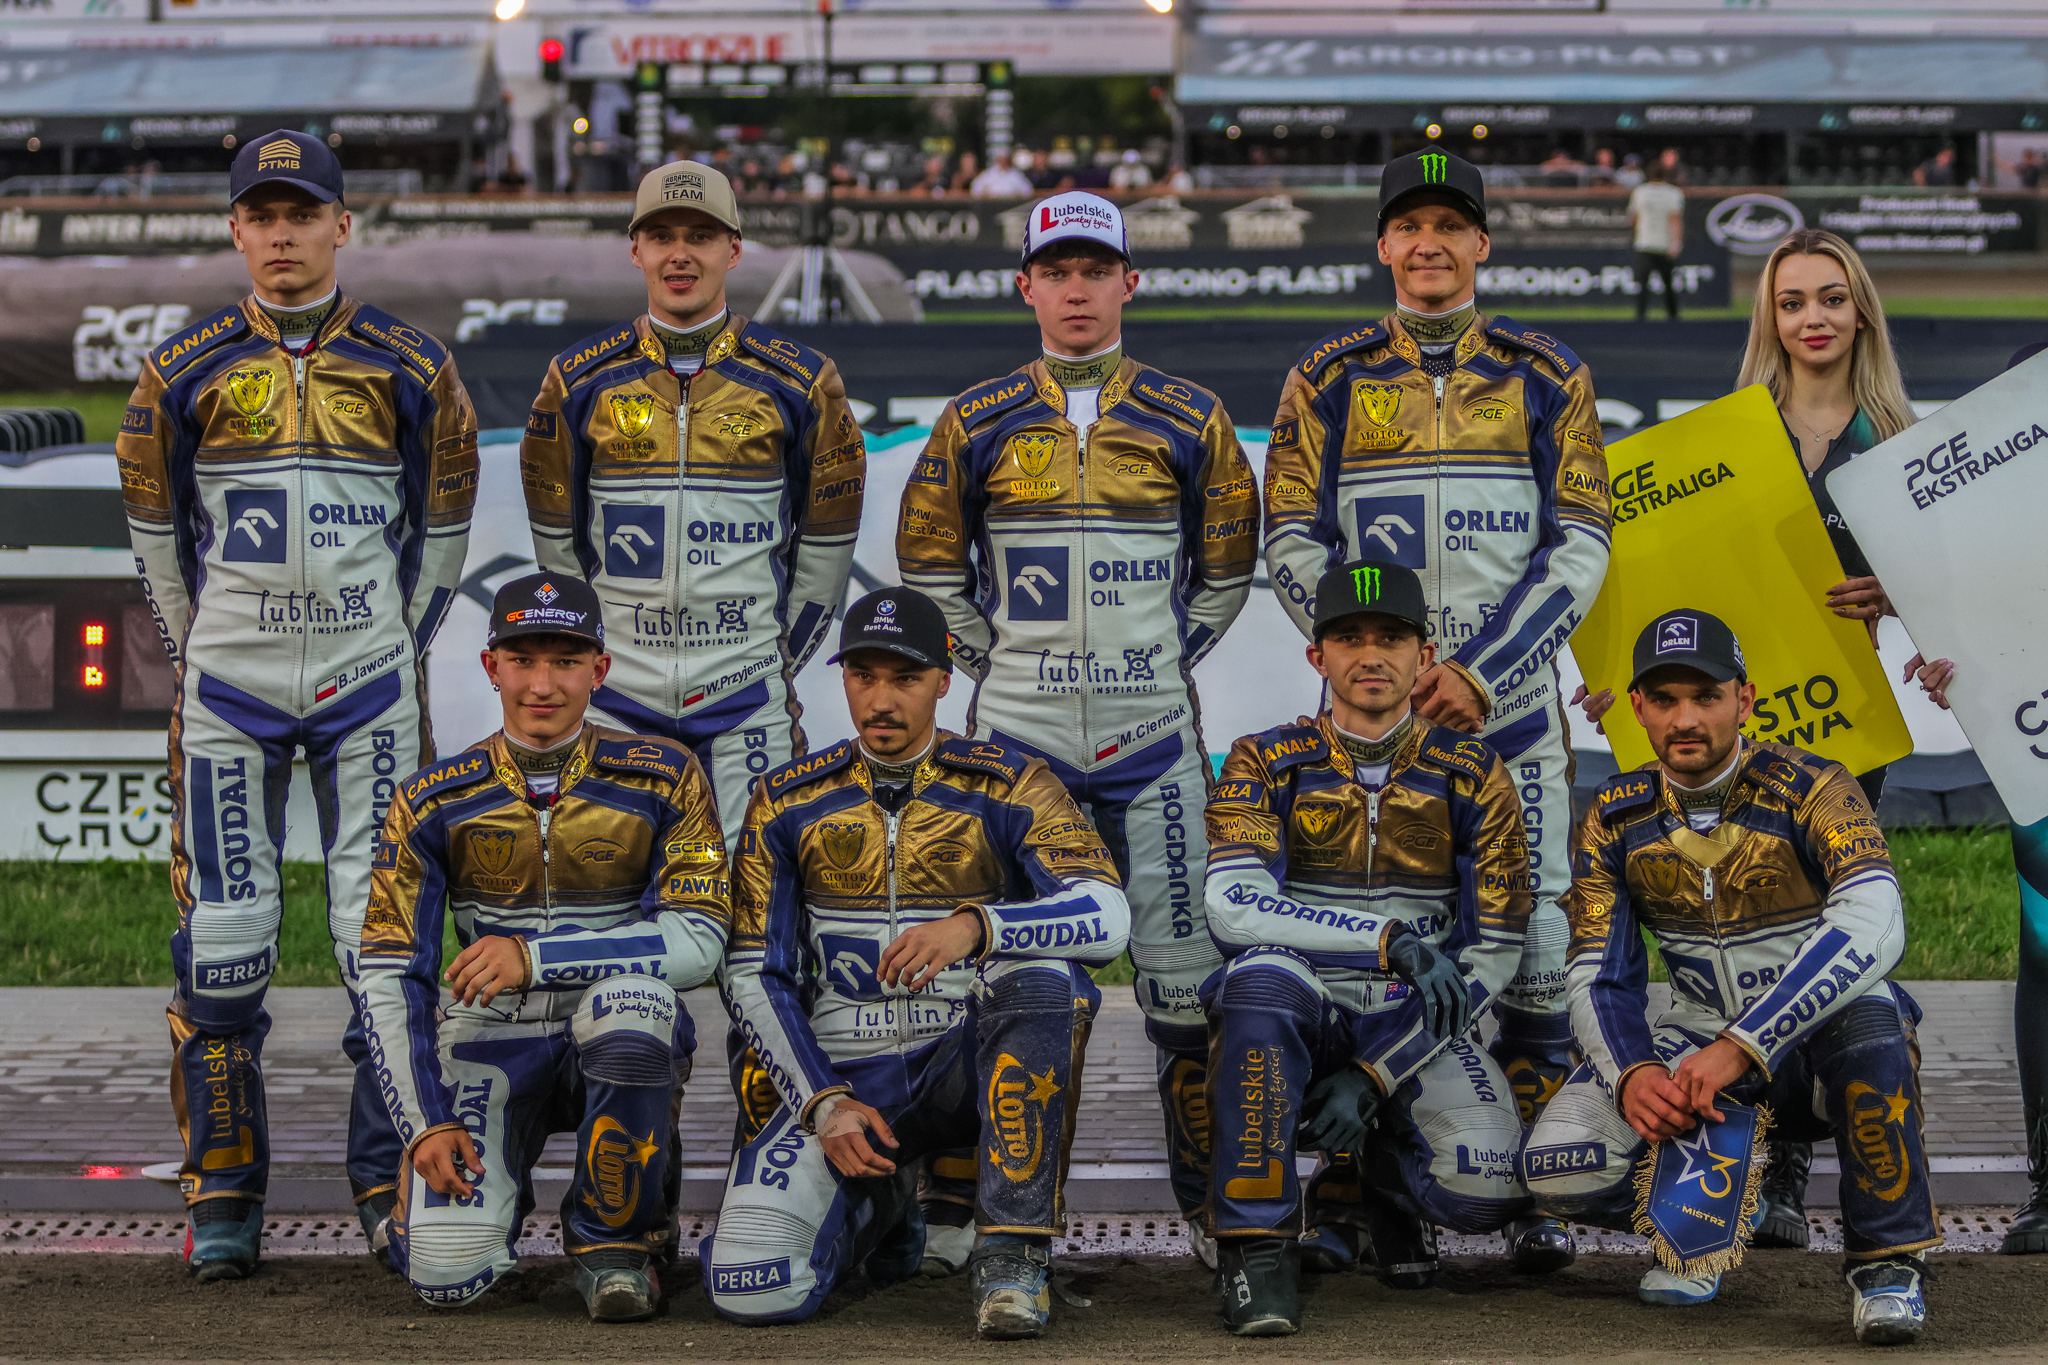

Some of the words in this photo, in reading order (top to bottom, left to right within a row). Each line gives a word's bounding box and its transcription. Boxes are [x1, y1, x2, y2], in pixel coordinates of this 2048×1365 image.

[258, 159, 300, 172] PTMB
[663, 189, 704, 201] TEAM
[158, 314, 236, 368] CANAL+
[359, 321, 437, 375] Mastermedia
[562, 329, 632, 374] CANAL+
[1302, 326, 1377, 374] CANAL+
[1491, 326, 1571, 374] Mastermedia
[744, 335, 813, 381] Mastermedia
[331, 401, 366, 415] PGE
[960, 380, 1028, 418] CANAL+
[1138, 382, 1205, 422] Mastermedia
[230, 417, 277, 430] MOTOR
[1471, 408, 1505, 420] PGE
[719, 422, 753, 436] PGE
[1360, 428, 1405, 441] MOTOR
[611, 441, 656, 452] MOTOR
[1115, 462, 1149, 476] PGE
[1903, 431, 1974, 491] PGE
[1910, 423, 2048, 511] EKSTRALIGA
[1012, 479, 1057, 491] MOTOR
[1019, 490, 1051, 498] LUBLIN
[1275, 484, 1307, 497] Auto
[308, 503, 388, 526] ORLEN
[905, 505, 931, 521] BMW
[1444, 509, 1530, 533] ORLEN
[310, 532, 346, 548] OIL
[686, 520, 775, 543] ORLEN
[903, 520, 929, 536] Best
[929, 524, 957, 541] Auto
[1444, 534, 1479, 551] OIL
[686, 548, 722, 566] OIL
[1089, 559, 1172, 582] ORLEN
[226, 587, 340, 623] lublin
[1090, 590, 1126, 607] OIL
[505, 607, 588, 624] GCENERGY
[541, 618, 576, 627] TECHNOLOGY
[603, 599, 711, 637] lublin
[872, 615, 895, 625] BMW
[258, 624, 304, 635] MIASTO
[312, 621, 374, 636] INSPIRACJI
[863, 623, 882, 632] Best
[882, 623, 903, 633] Auto
[633, 638, 676, 648] MIASTO
[683, 635, 749, 649] INSPIRACJI
[1660, 635, 1691, 648] ORLEN
[338, 639, 406, 690] B.Jaworski
[1004, 647, 1119, 684] lublin
[1494, 609, 1583, 703] SOUDAL
[704, 650, 779, 696] W.Przyjemski
[1037, 684, 1081, 694] MIASTO
[1091, 683, 1159, 695] INSPIRACJI
[1740, 674, 1839, 735] STO
[1119, 702, 1187, 748] M.Cierniak
[407, 758, 484, 800] CANAL+
[599, 754, 681, 782] Mastermedia
[770, 746, 848, 788] CANAL+
[940, 751, 1018, 783] Mastermedia
[217, 757, 256, 901] SOUDAL
[1239, 830, 1272, 842] Auto
[1402, 834, 1438, 849] PGE
[581, 850, 616, 863] PGE
[927, 850, 962, 864] PGE
[1158, 782, 1194, 940] BOGDANKA
[823, 871, 869, 883] MOTOR
[1223, 882, 1378, 933] BOGDANKA
[1000, 917, 1109, 951] SOUDAL
[206, 956, 268, 985] PERŁA
[1757, 946, 1877, 1055] SOUDAL
[853, 1029, 900, 1038] MIASTO
[360, 990, 414, 1141] BOGDANKA
[997, 1081, 1030, 1159] LOTTO
[1854, 1105, 1899, 1180] LOTTO
[1531, 1148, 1599, 1174] PERŁA
[597, 1140, 629, 1209] LOTTO
[1681, 1203, 1726, 1228] MISTRZ
[717, 1265, 781, 1290] PERŁA
[419, 1278, 486, 1302] PERŁA
